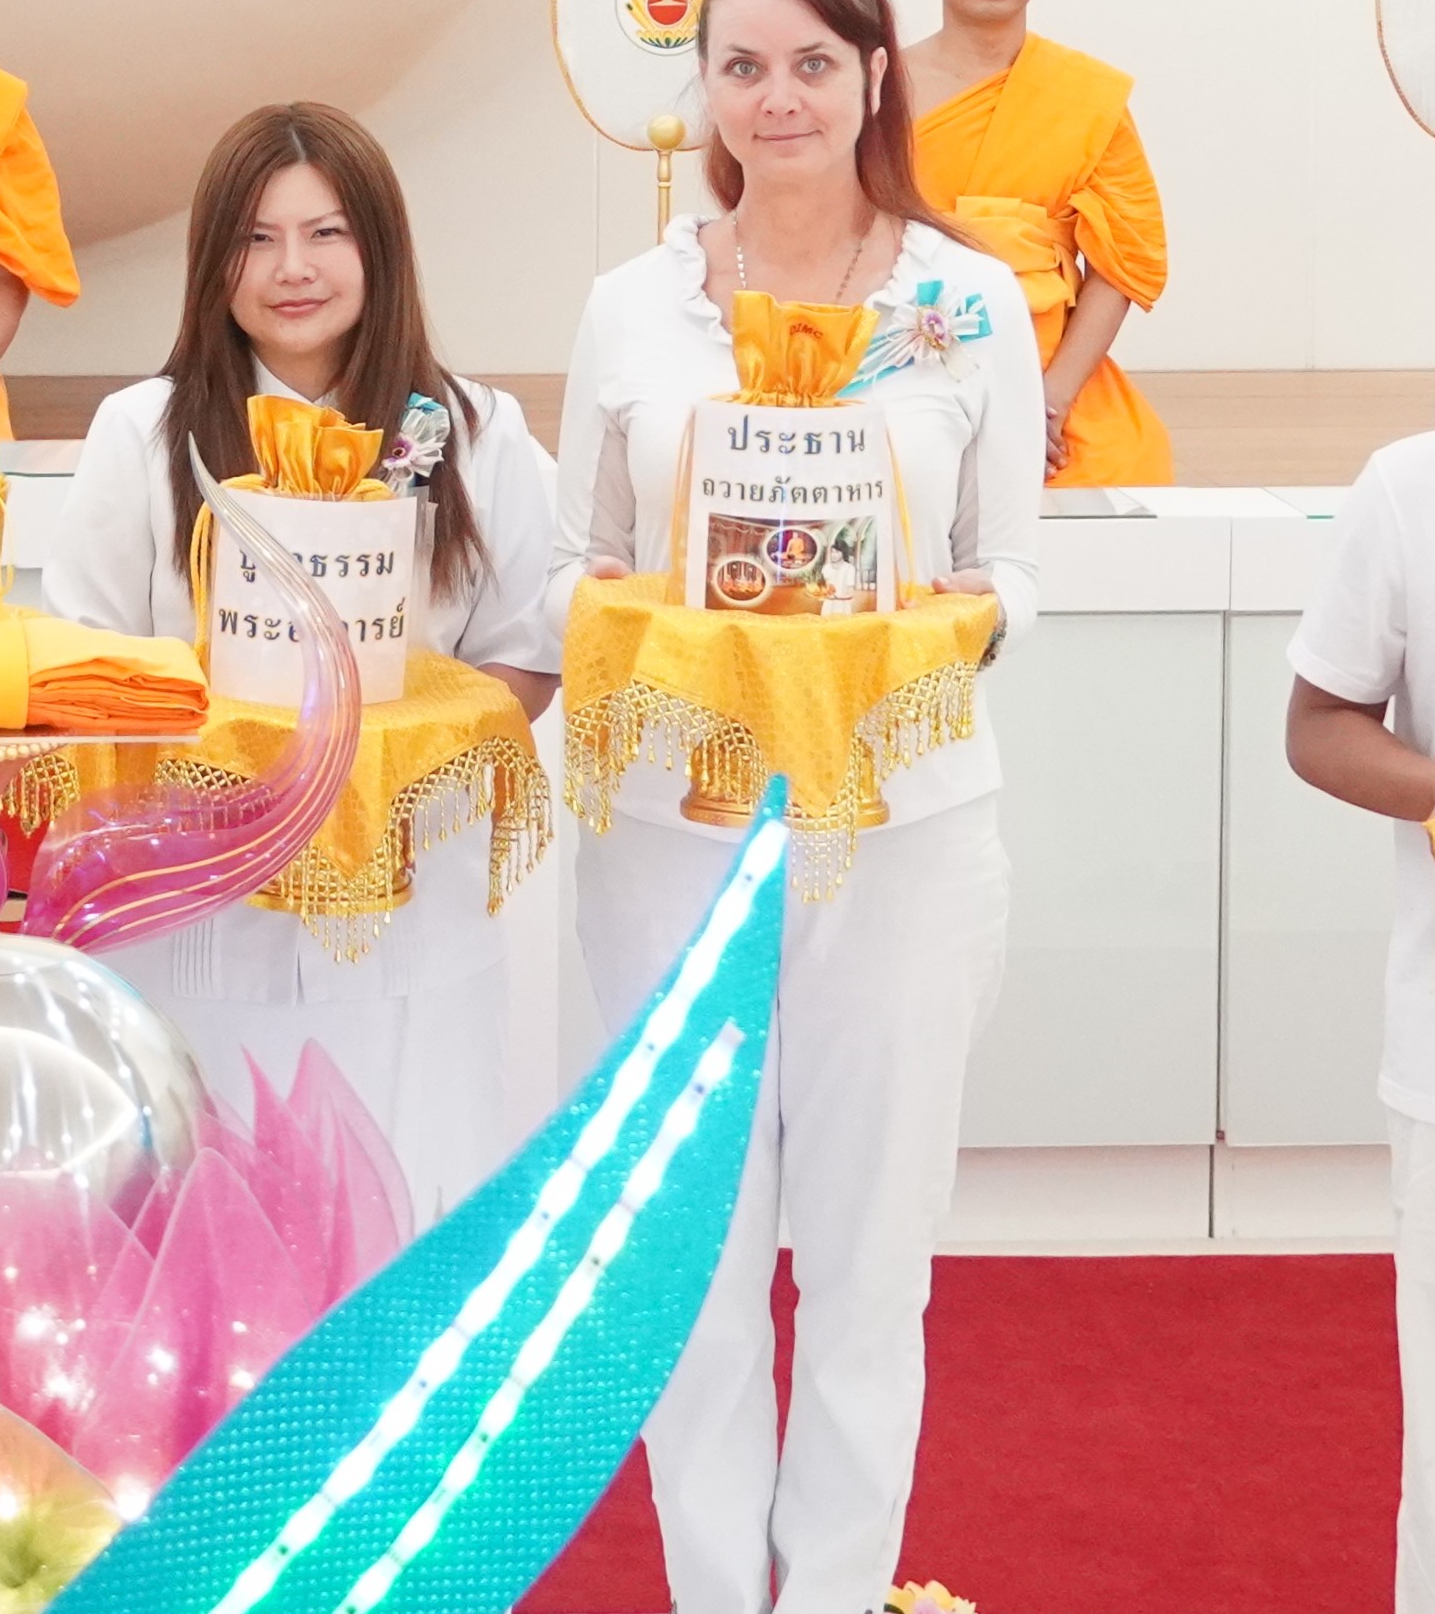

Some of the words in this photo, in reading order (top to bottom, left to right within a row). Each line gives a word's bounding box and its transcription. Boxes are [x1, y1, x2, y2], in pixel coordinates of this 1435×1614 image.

[726, 413, 867, 456] ประธาน
[702, 474, 885, 505] ถวายภัตตาหาร
